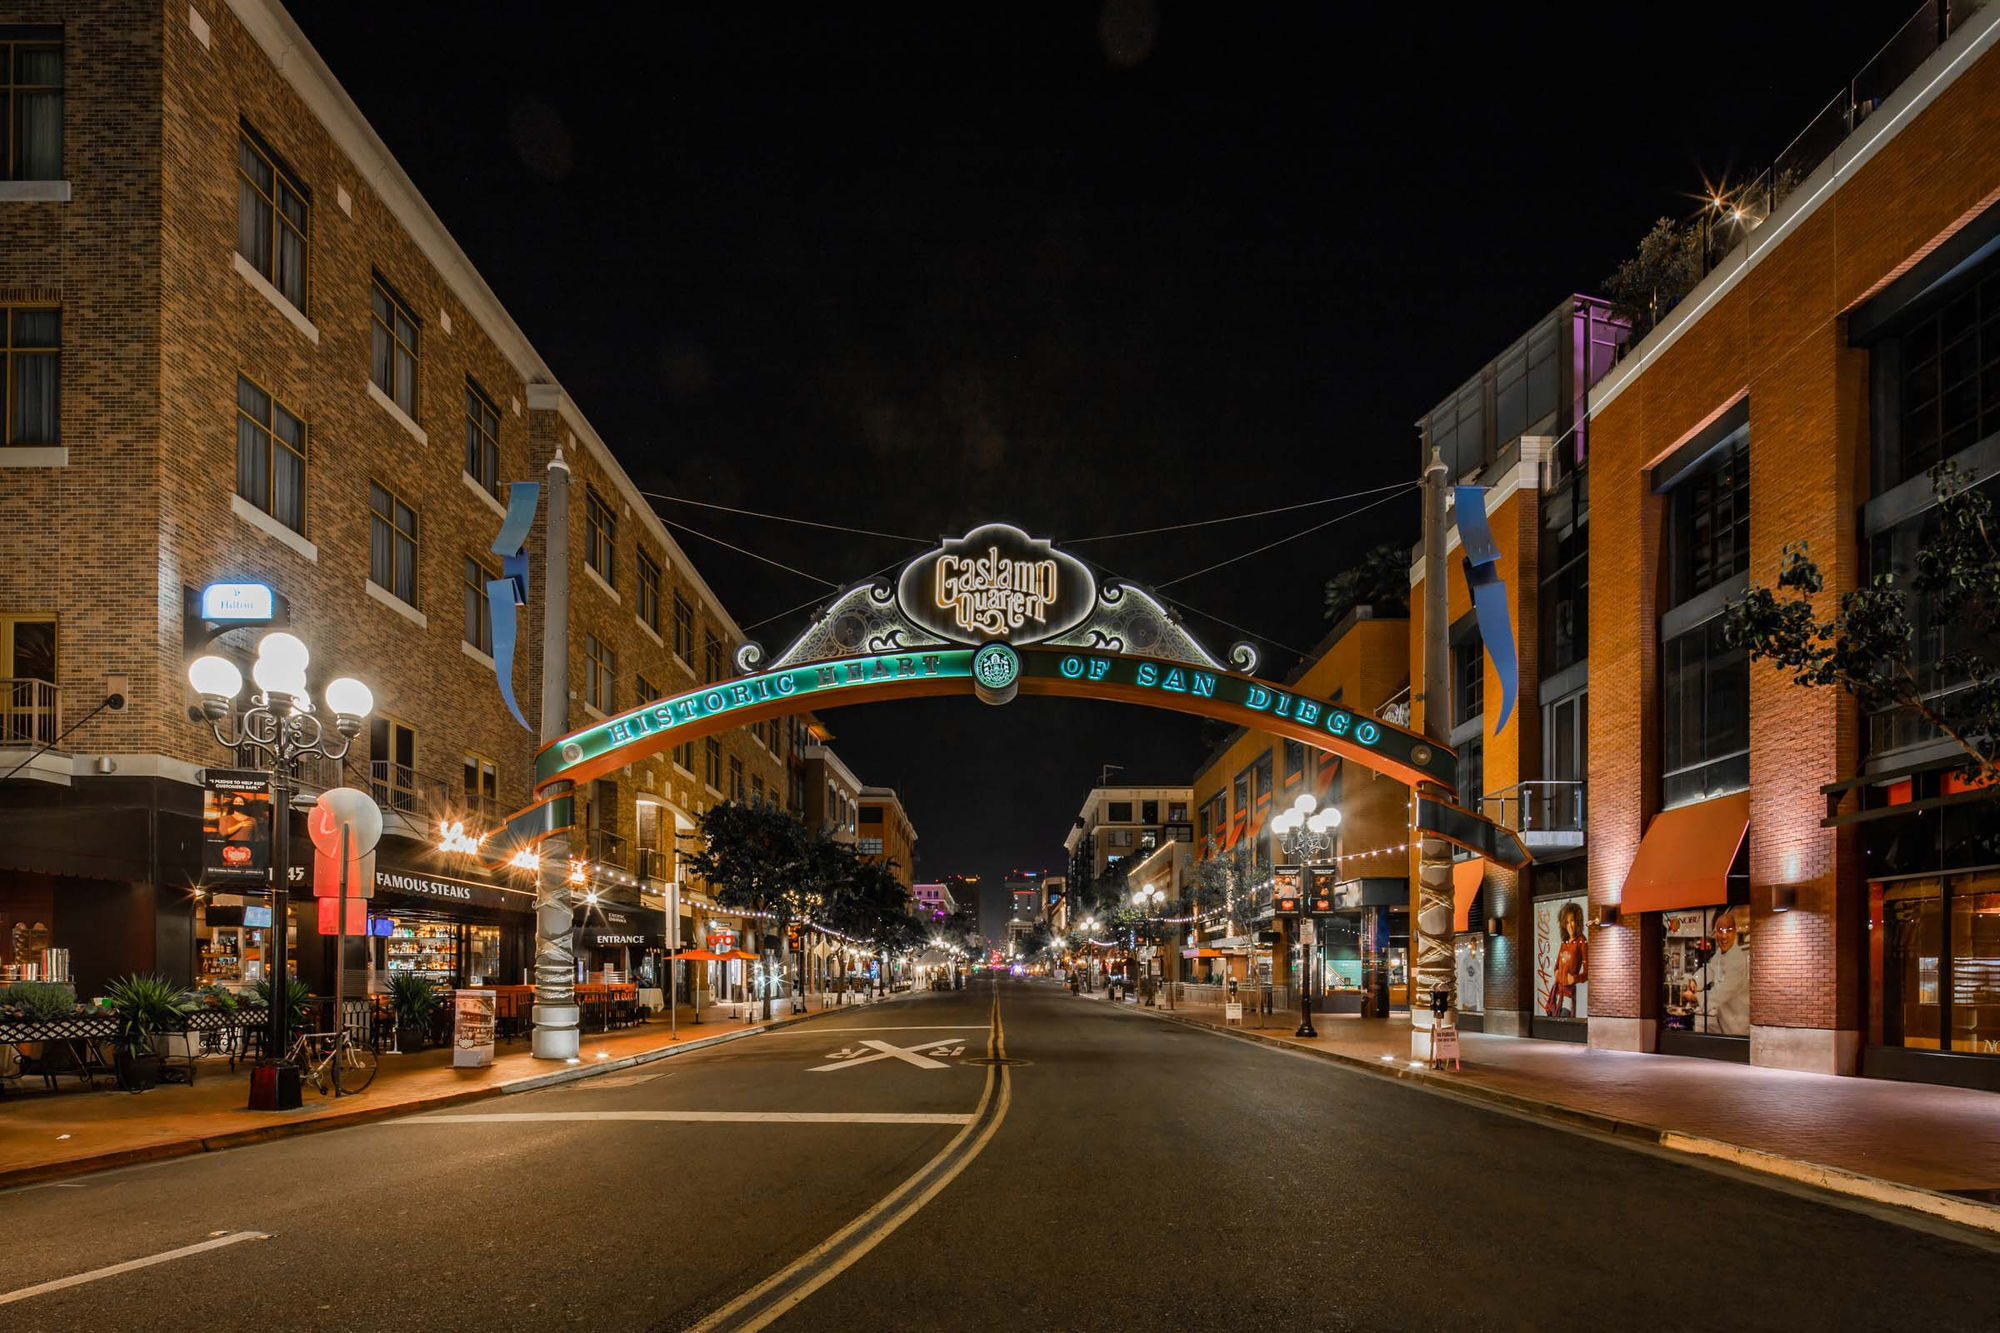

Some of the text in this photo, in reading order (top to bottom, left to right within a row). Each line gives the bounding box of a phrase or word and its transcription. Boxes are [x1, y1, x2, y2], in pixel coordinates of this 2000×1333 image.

[935, 547, 1058, 608] Gaslamp
[955, 588, 1047, 635] Quarter
[607, 672, 796, 745] HISTORIC
[815, 655, 941, 689] HEART
[1060, 654, 1110, 679] OF
[1137, 662, 1217, 698] SAN
[1246, 686, 1382, 746] DIEGO
[376, 872, 471, 900] FAMOUS STEAKS
[597, 935, 645, 944] ENTRANCE
